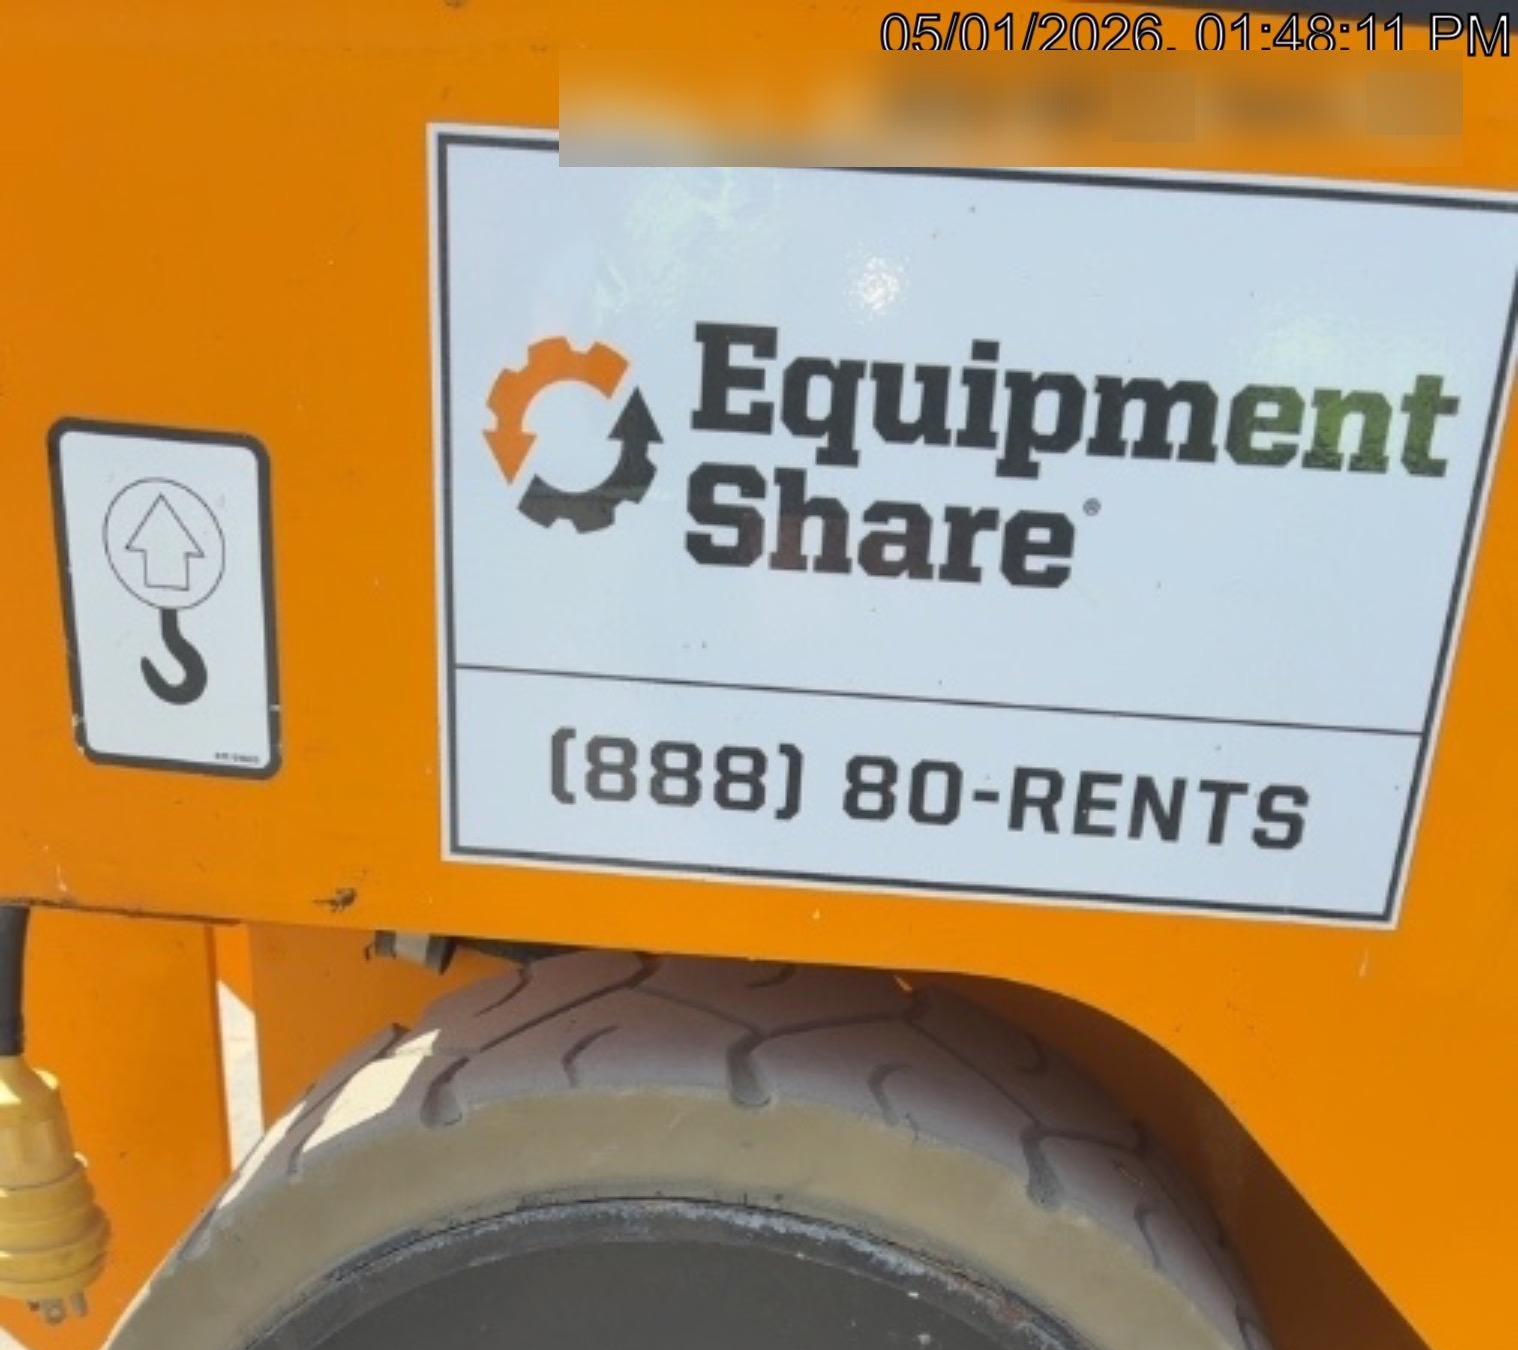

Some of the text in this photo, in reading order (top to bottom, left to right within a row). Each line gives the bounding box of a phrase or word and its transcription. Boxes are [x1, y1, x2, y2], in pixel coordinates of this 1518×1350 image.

[689, 322, 1459, 480] Equipment
[552, 728, 1308, 849] (888) 80-RENTS
